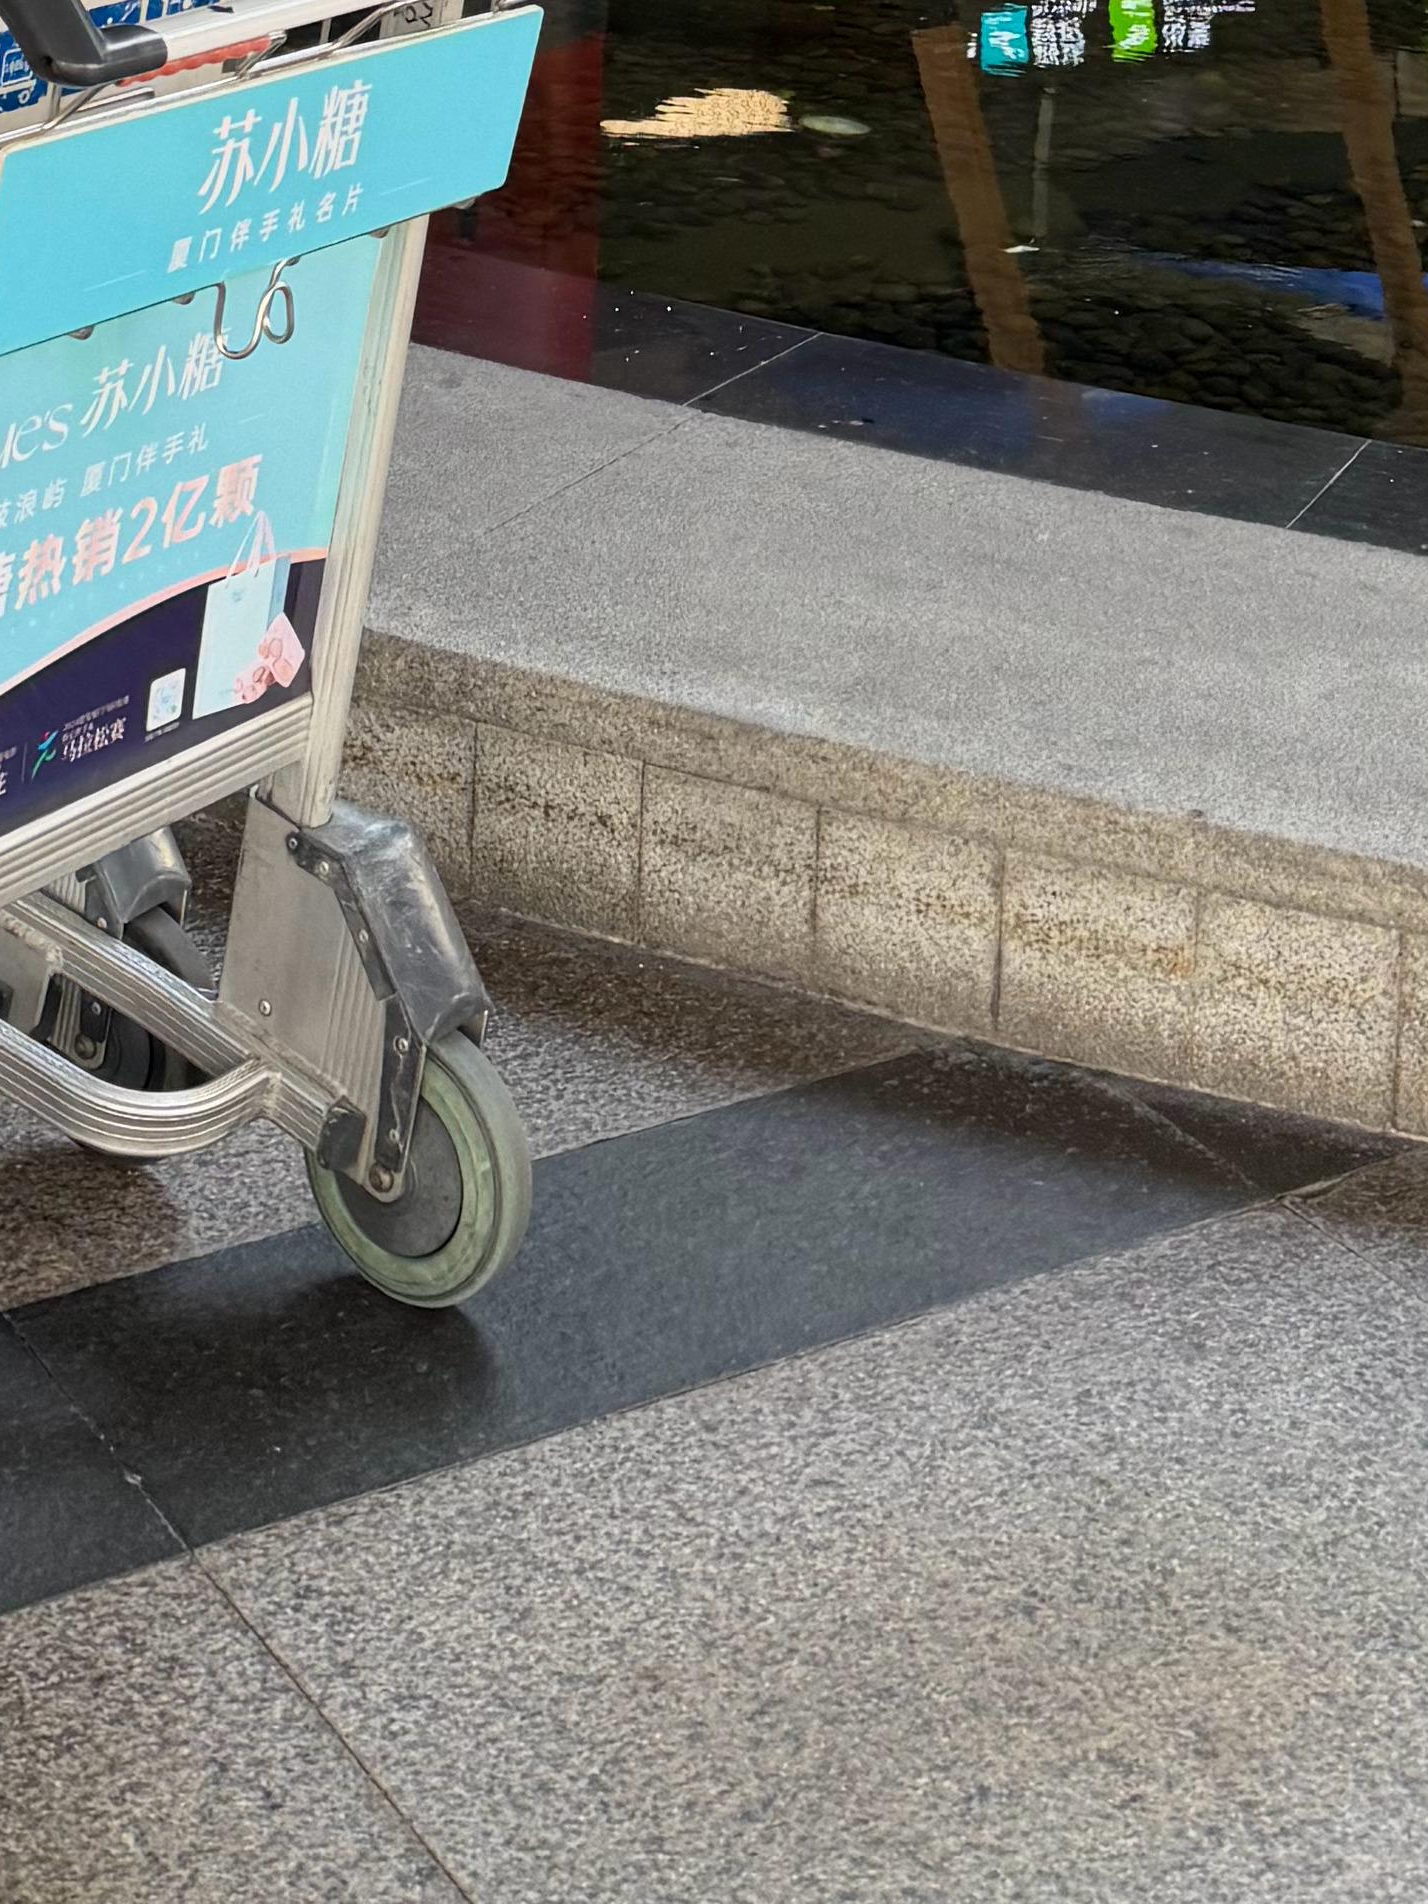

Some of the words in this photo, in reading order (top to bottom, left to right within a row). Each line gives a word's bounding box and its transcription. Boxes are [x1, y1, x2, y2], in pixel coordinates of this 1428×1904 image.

[197, 79, 372, 215] 苏小糖
[166, 184, 364, 274] 厦门伴手礼名片
[80, 327, 232, 438] 苏小糖
[80, 422, 208, 497] 厦门伴手礼
[61, 716, 128, 763] 马拉松赛
